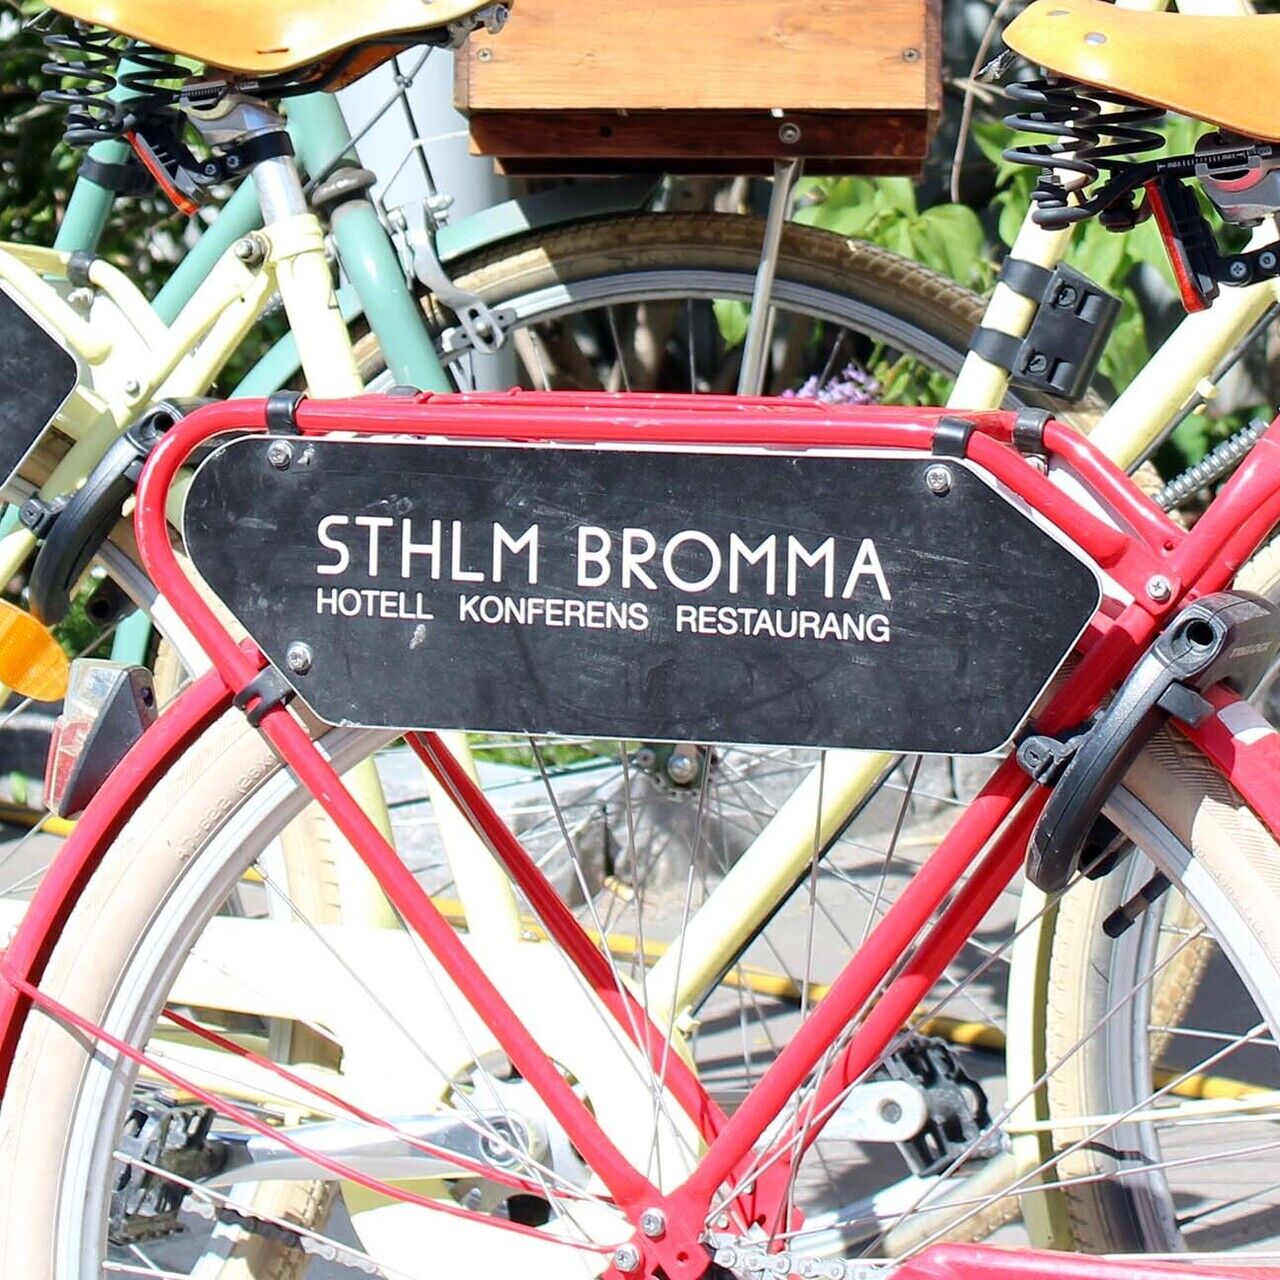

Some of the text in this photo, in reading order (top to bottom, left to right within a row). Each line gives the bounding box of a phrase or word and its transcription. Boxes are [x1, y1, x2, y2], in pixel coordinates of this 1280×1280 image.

[316, 514, 892, 602] STHLM BROMMA
[316, 587, 891, 643] HOTELL KONFERENS RESTAURANG
